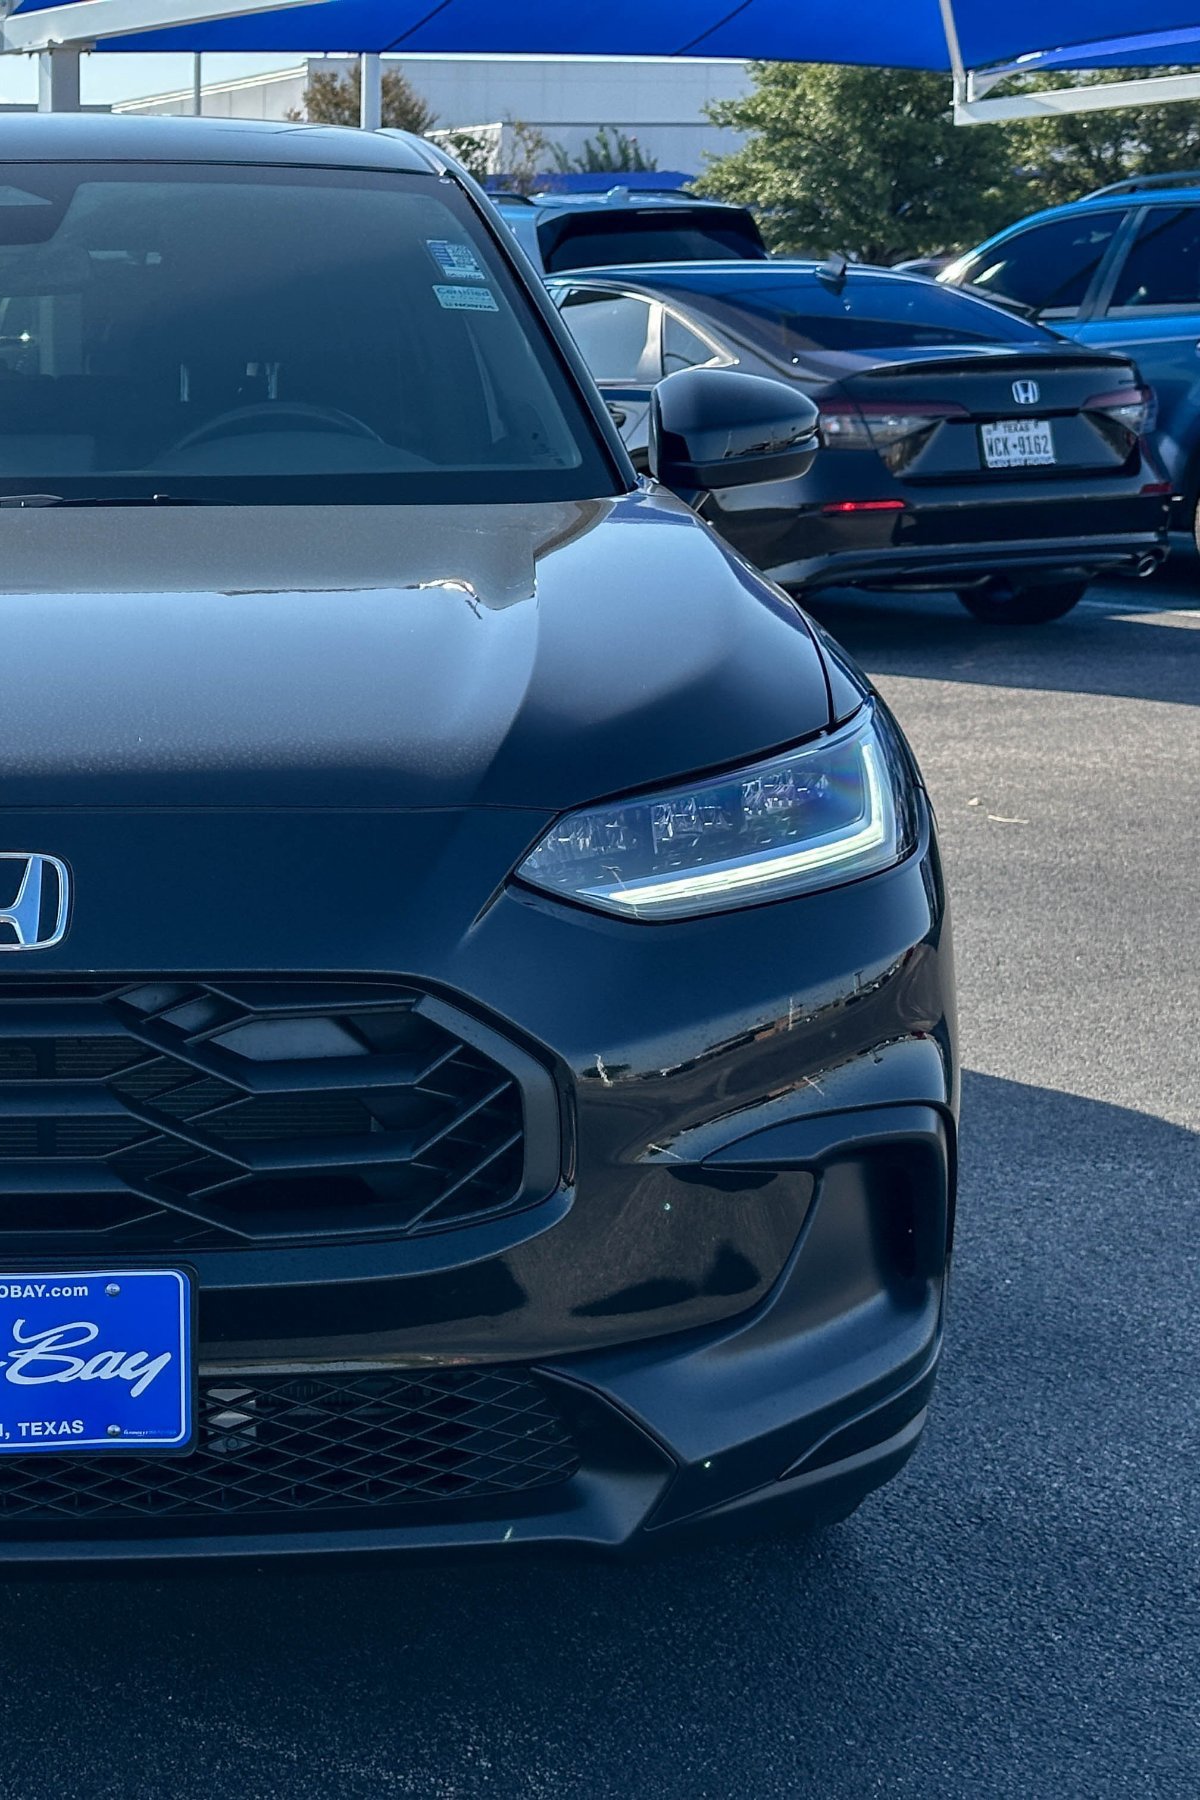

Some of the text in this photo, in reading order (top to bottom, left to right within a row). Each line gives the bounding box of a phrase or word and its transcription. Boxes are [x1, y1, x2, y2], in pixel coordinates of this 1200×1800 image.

[1003, 423, 1030, 433] TEXAS
[4, 1318, 172, 1398] Bay
[17, 1420, 85, 1437] TEXAS
